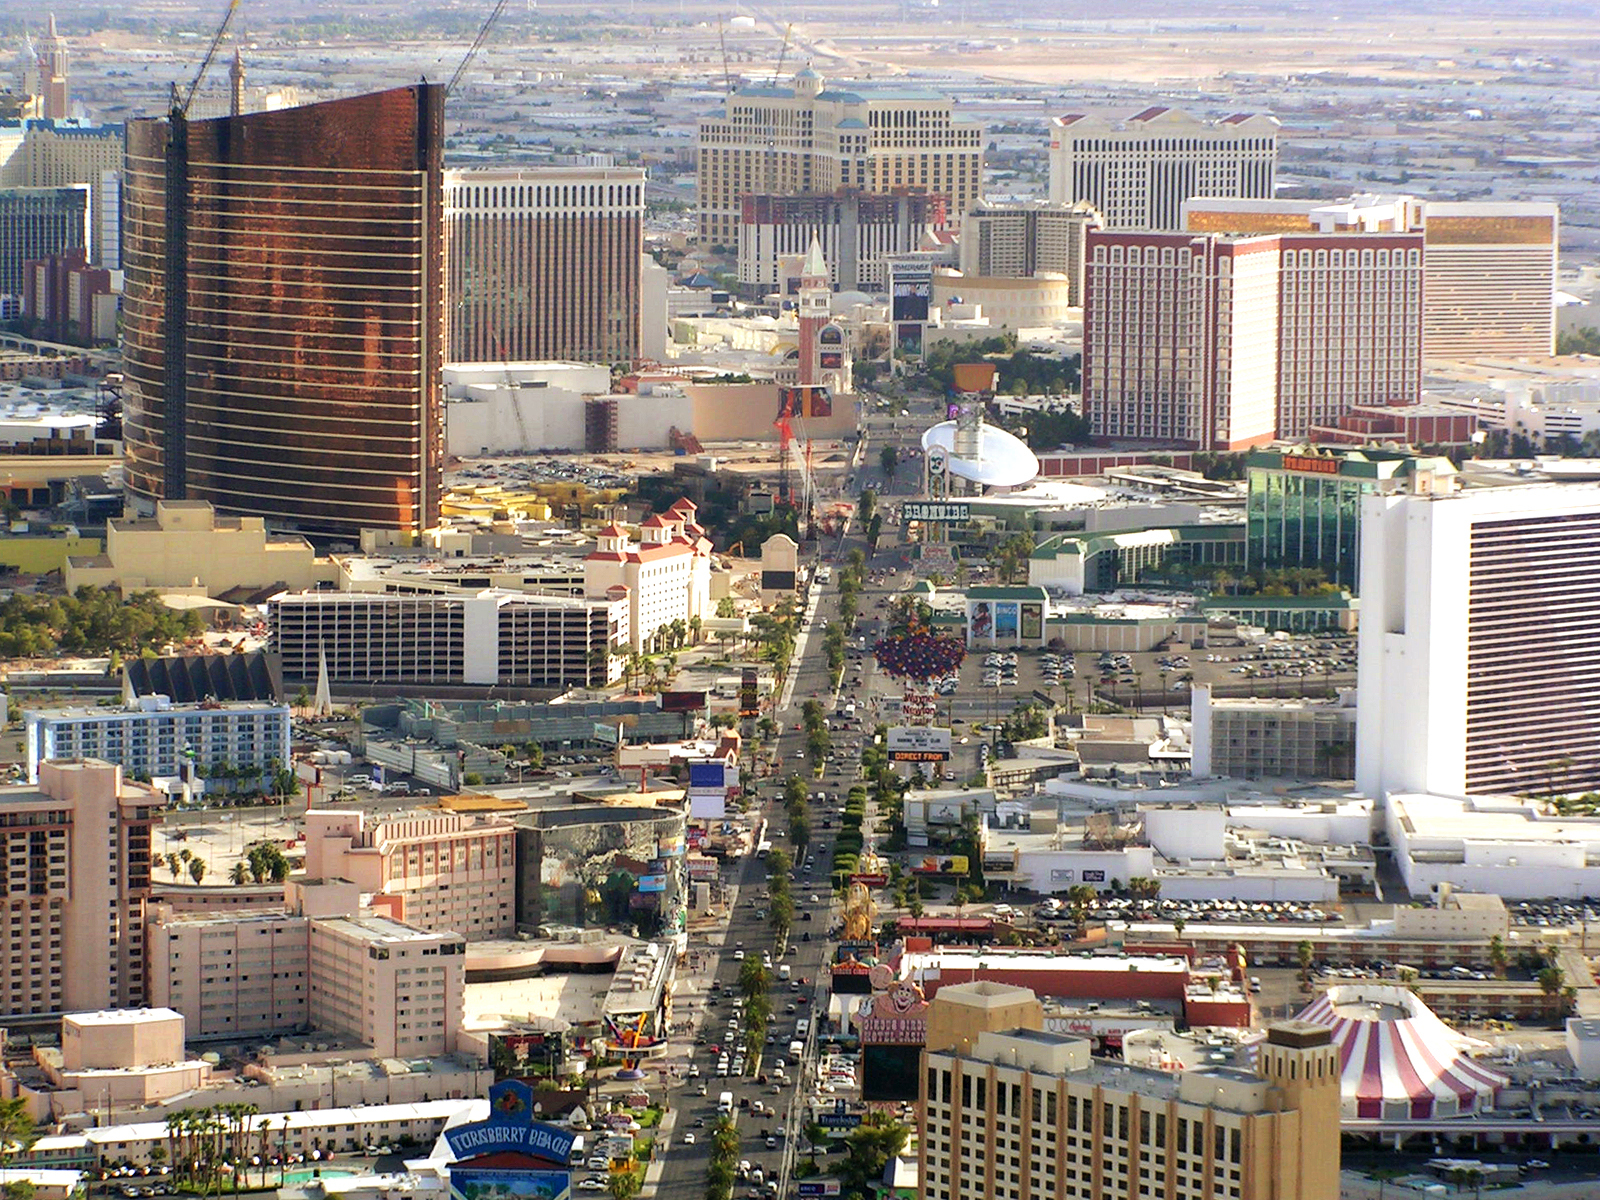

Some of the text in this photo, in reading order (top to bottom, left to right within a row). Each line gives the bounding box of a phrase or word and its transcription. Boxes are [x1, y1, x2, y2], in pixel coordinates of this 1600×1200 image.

[903, 692, 934, 704] Wayne
[903, 705, 935, 715] Newton
[863, 1019, 897, 1031] CIRCUS
[864, 1031, 896, 1043] HOTEL
